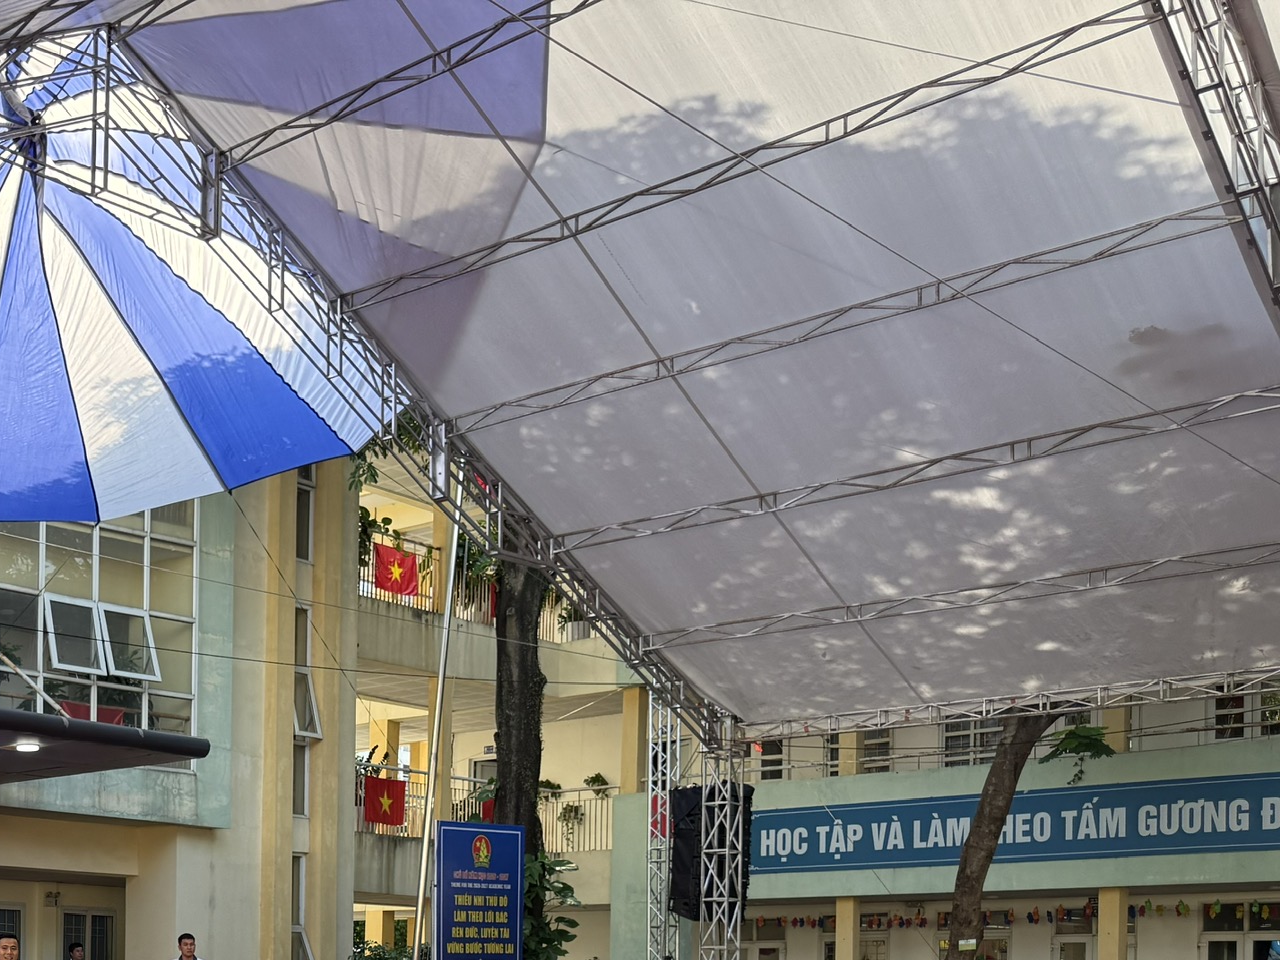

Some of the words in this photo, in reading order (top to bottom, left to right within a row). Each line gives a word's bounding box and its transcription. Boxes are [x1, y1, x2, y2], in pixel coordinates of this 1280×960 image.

[760, 827, 808, 862] HỌC
[816, 819, 864, 859] TẬP
[871, 815, 905, 850] VÀ
[913, 812, 971, 848] LÀM
[998, 812, 1051, 845] HEO
[1061, 796, 1126, 840] TẤM
[1137, 797, 1250, 837] GƯƠNG
